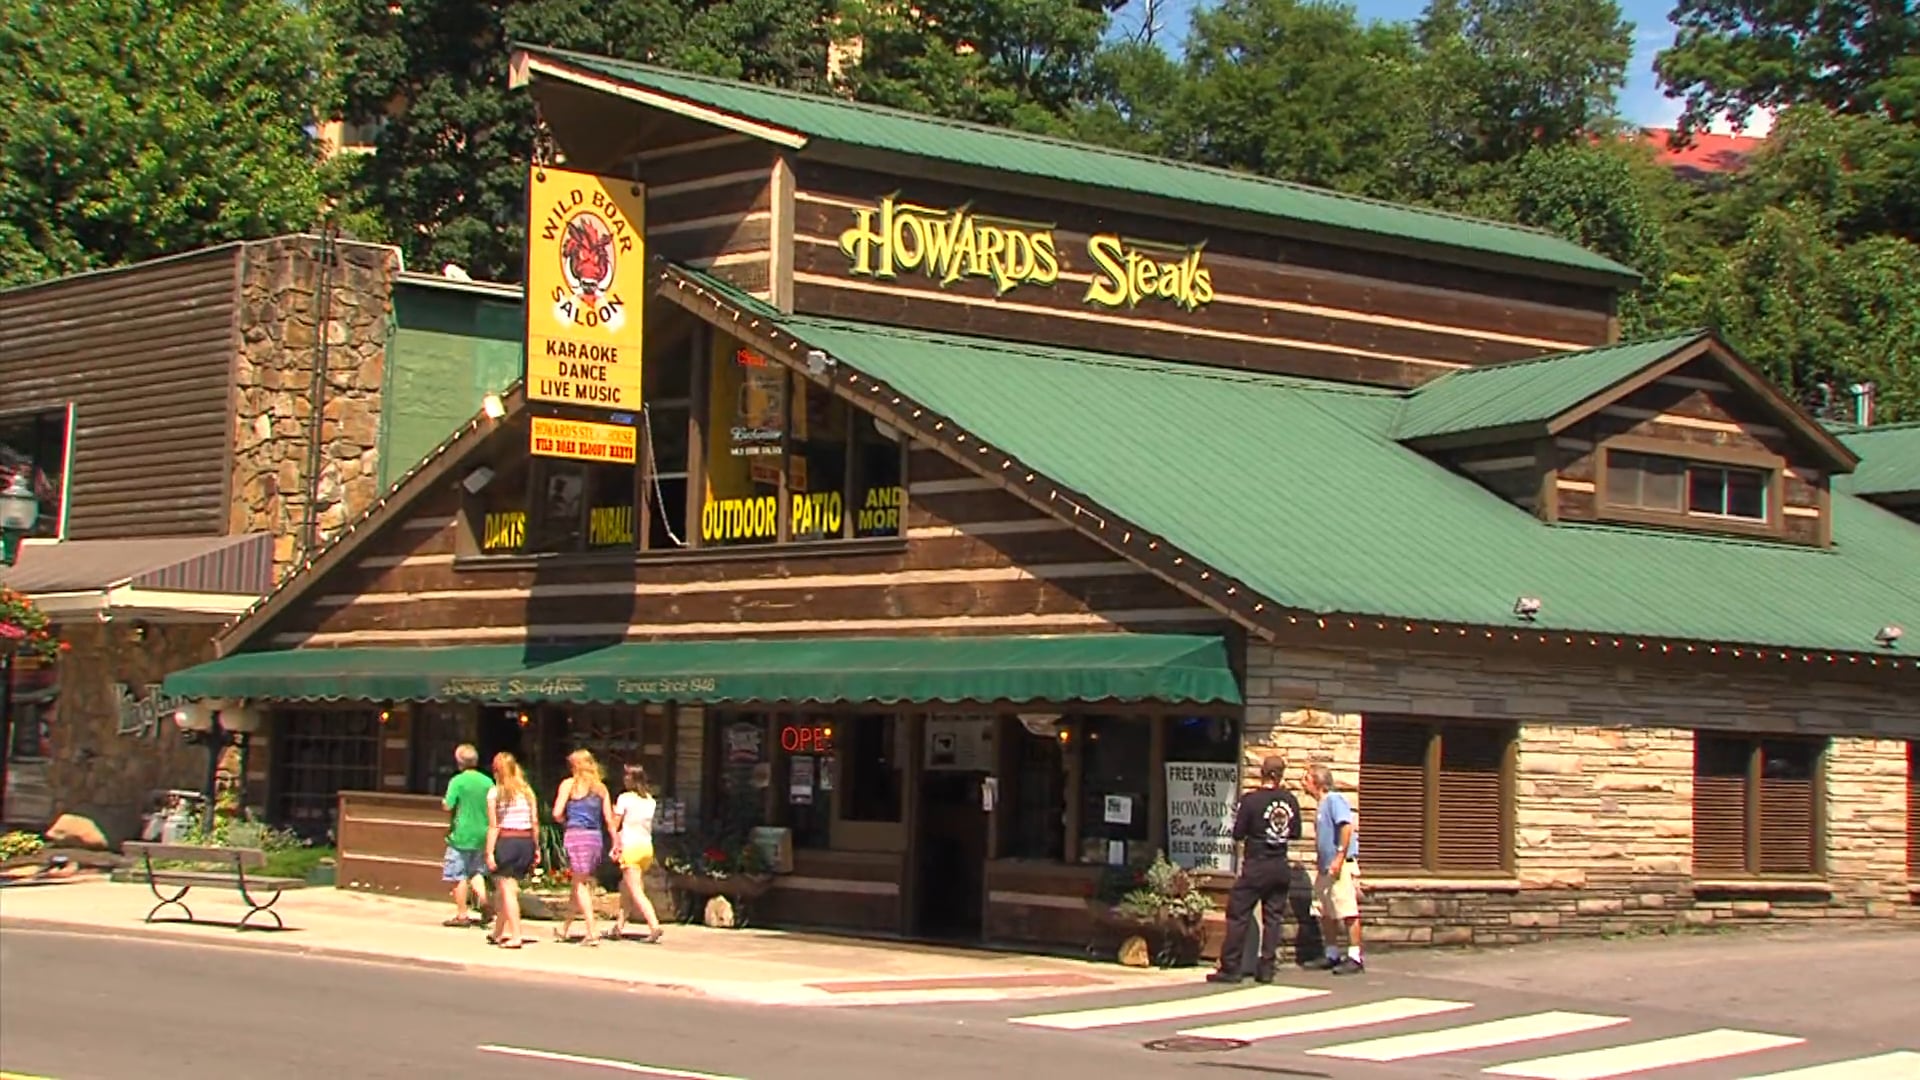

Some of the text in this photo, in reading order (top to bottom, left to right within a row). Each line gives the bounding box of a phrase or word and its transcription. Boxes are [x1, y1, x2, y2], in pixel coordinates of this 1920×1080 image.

[543, 189, 633, 256] WILD BOAR
[839, 192, 1214, 312] HOWARDS Steaks
[552, 286, 624, 328] SALOON
[546, 340, 618, 363] KARAOKE
[559, 361, 607, 382] DANCE
[541, 380, 621, 403] LIVE MUSIC
[866, 486, 904, 507] AND
[589, 506, 633, 544] PINBALL
[703, 491, 842, 540] OUTDOOR PATIO
[859, 509, 898, 530] MOR
[484, 511, 526, 549] DARTS
[781, 726, 825, 751] OPE
[1169, 766, 1237, 783] FREE PARKING
[1193, 782, 1217, 797] PASS
[1171, 841, 1191, 853] SEE
[1194, 856, 1219, 869] HERE
